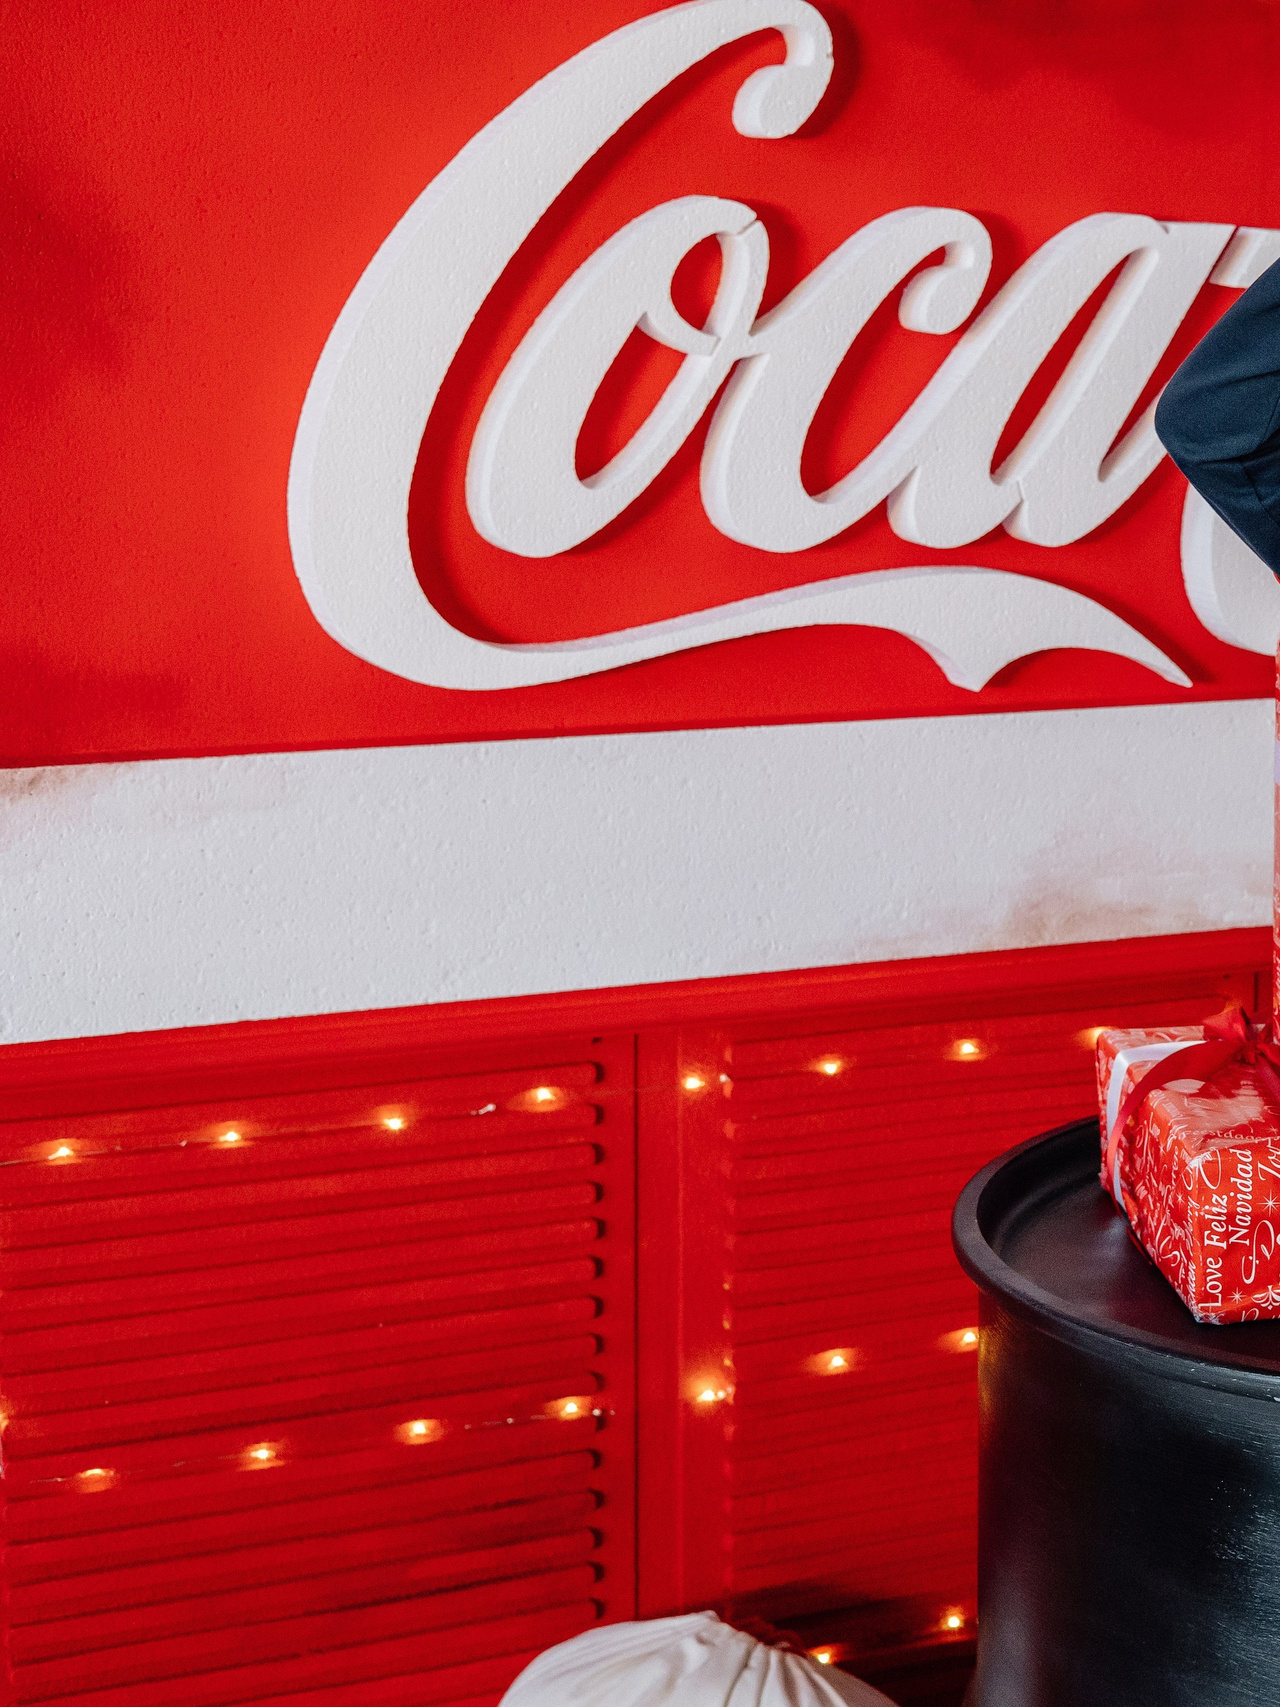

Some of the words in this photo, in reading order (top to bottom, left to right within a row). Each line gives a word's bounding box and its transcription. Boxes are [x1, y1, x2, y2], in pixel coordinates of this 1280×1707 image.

[1204, 1193, 1228, 1250] Feliz
[1228, 1148, 1253, 1246] Navidad
[1199, 1257, 1223, 1308] Love
